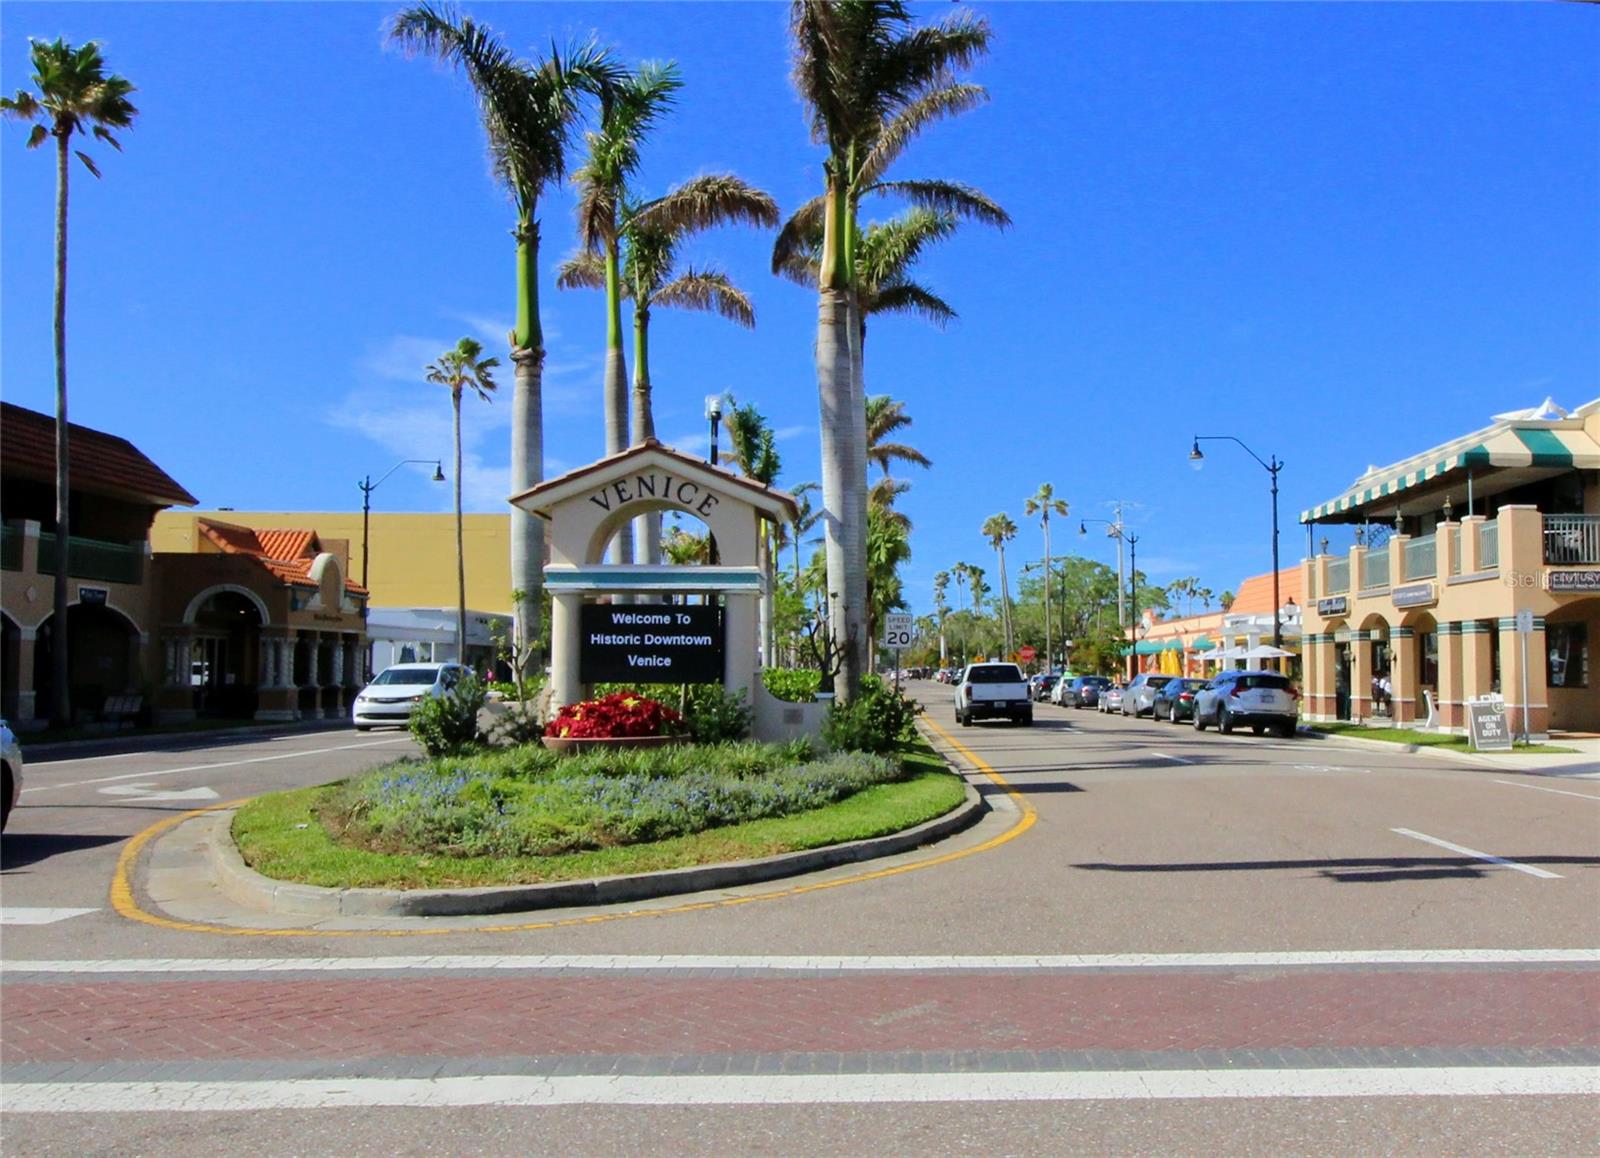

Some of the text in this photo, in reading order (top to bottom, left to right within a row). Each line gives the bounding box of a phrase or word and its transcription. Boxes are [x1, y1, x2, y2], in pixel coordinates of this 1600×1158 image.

[590, 474, 719, 517] VENICE
[612, 613, 691, 624] Welcome To
[590, 634, 712, 645] Historic Downtown
[887, 632, 910, 645] 20
[628, 655, 672, 667] Venice
